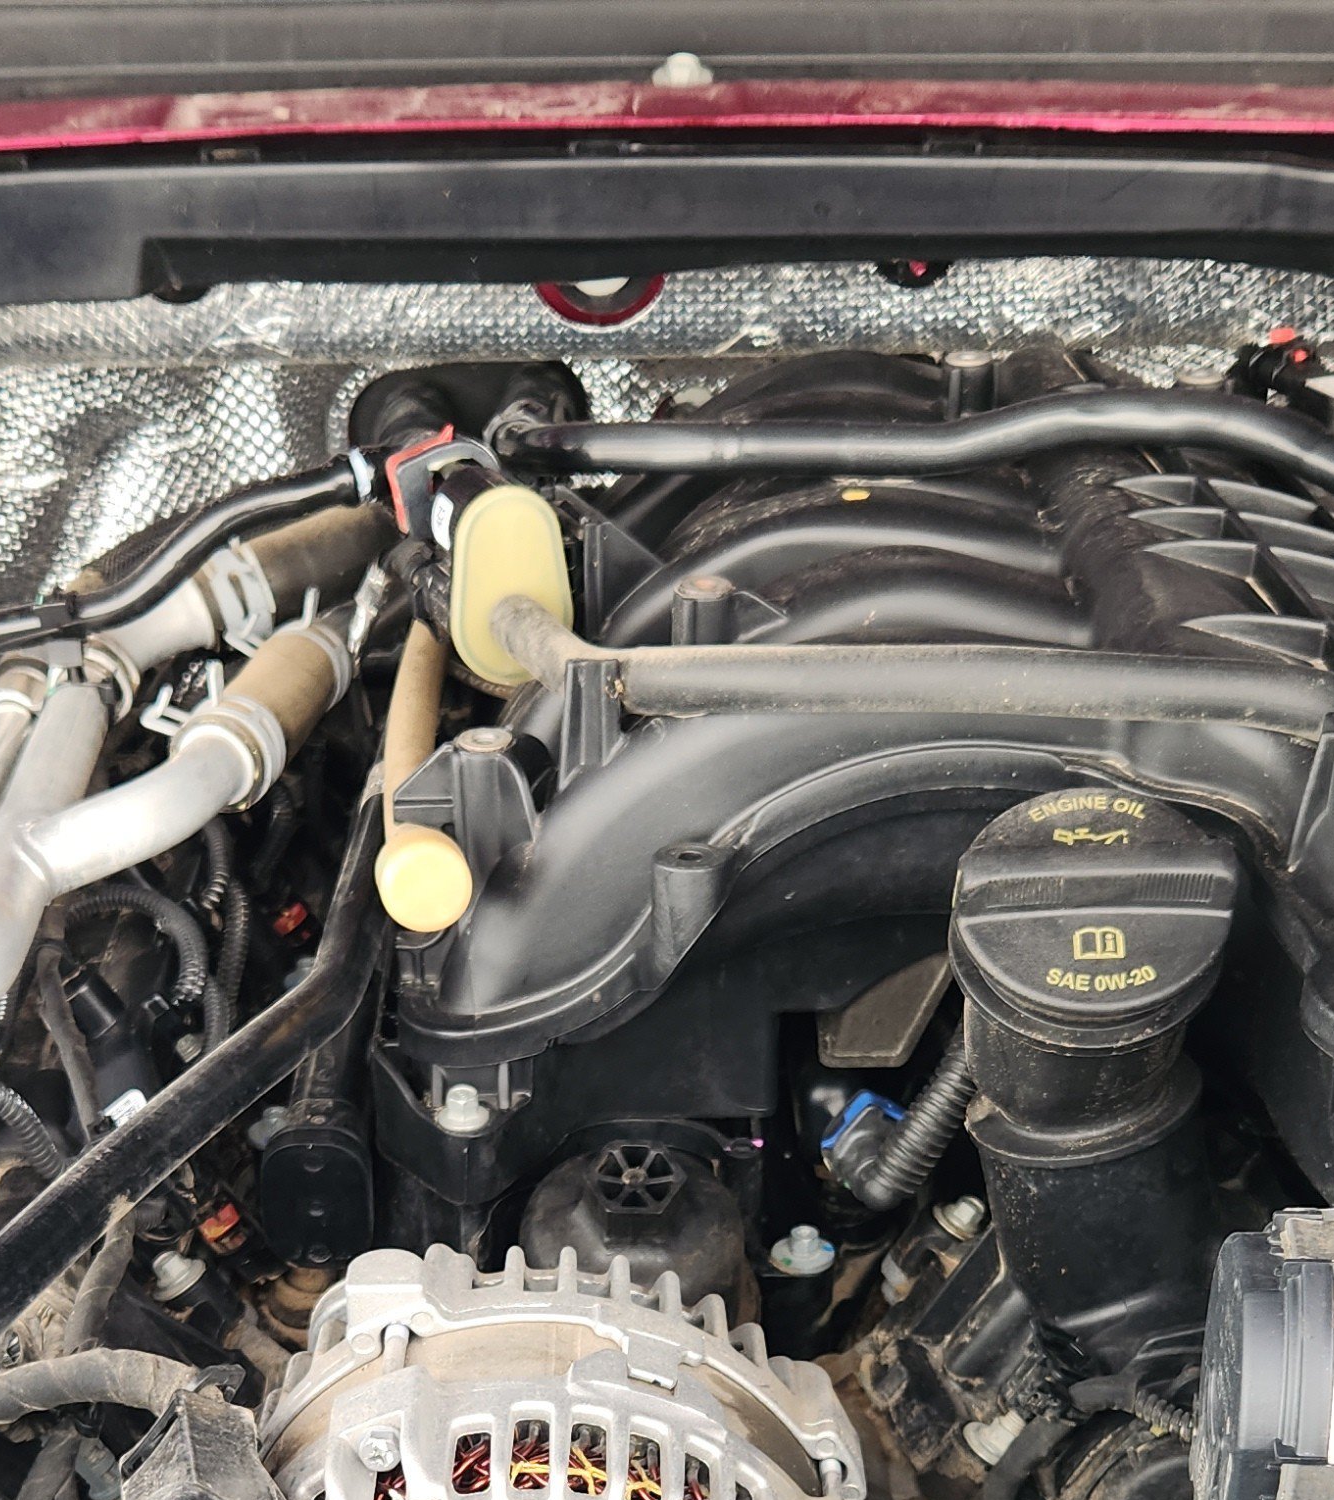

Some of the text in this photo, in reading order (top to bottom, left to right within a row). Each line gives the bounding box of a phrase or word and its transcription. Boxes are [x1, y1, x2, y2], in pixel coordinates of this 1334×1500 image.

[1028, 795, 1146, 822] ENGINE OIL
[1046, 965, 1157, 992] SAE 0W-20
